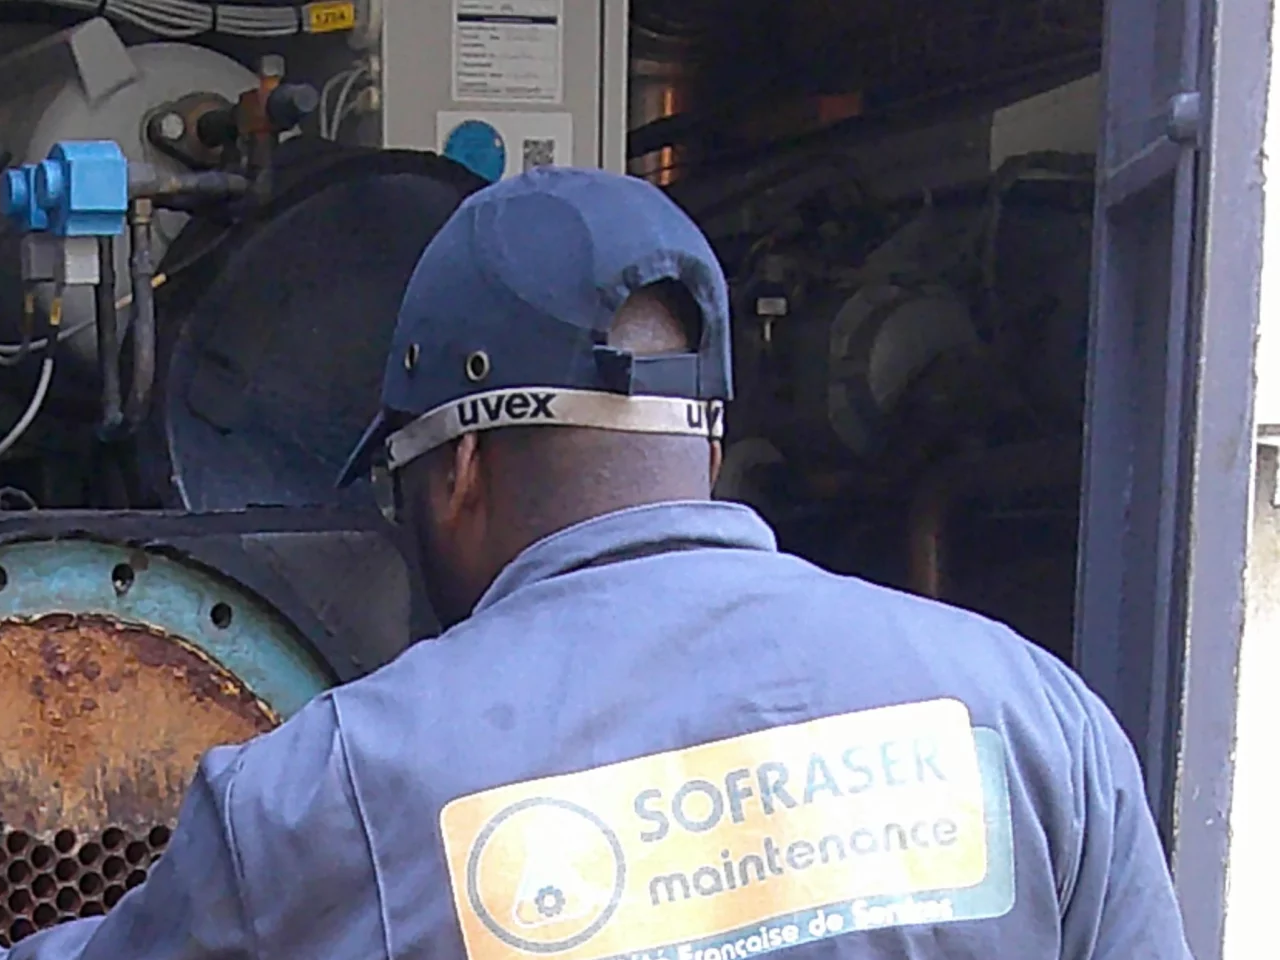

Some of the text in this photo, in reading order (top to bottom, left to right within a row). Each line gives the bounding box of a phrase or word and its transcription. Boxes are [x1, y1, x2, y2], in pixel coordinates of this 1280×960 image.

[458, 392, 558, 428] uvex
[633, 737, 946, 843] SOFRASER
[648, 817, 958, 906] maintenance
[808, 909, 844, 940] de
